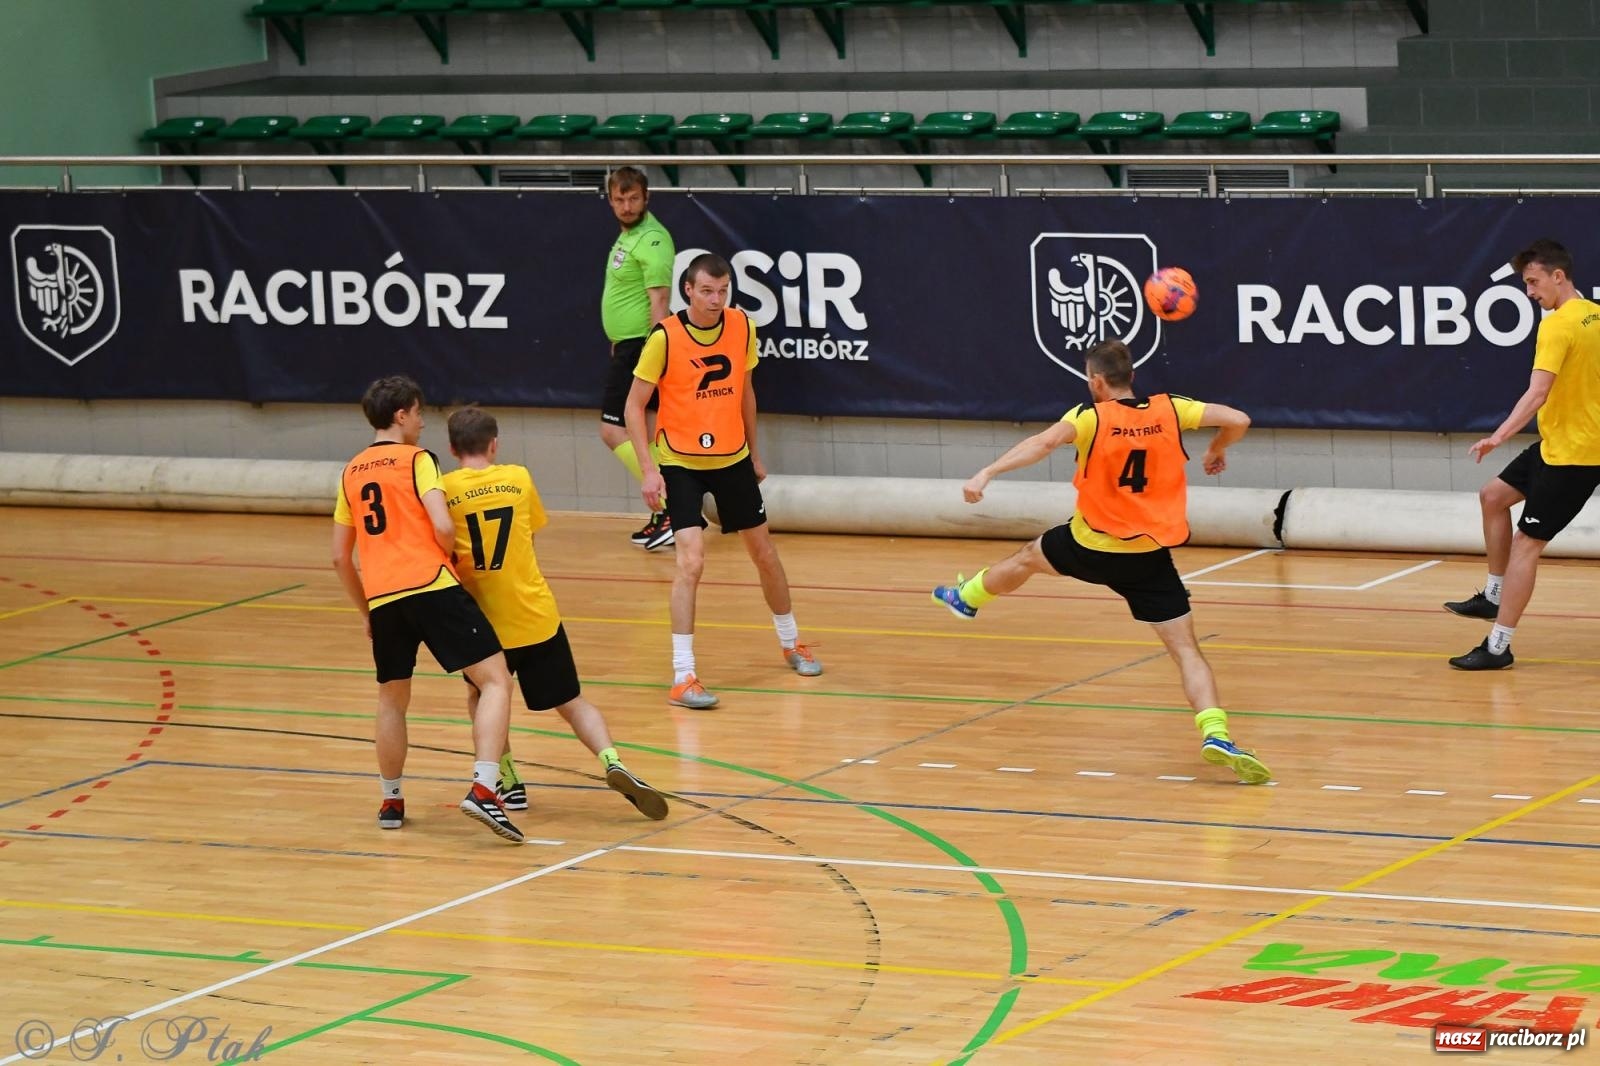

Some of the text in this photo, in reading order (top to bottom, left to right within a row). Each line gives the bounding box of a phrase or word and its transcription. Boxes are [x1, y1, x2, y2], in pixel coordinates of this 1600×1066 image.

[179, 251, 508, 329] RACIBÓRZ
[696, 386, 734, 400] PATRICK
[701, 433, 712, 448] 8
[358, 457, 397, 472] PATRICK
[1118, 449, 1148, 493] 4
[361, 482, 387, 535] 3
[465, 505, 513, 571] 17
